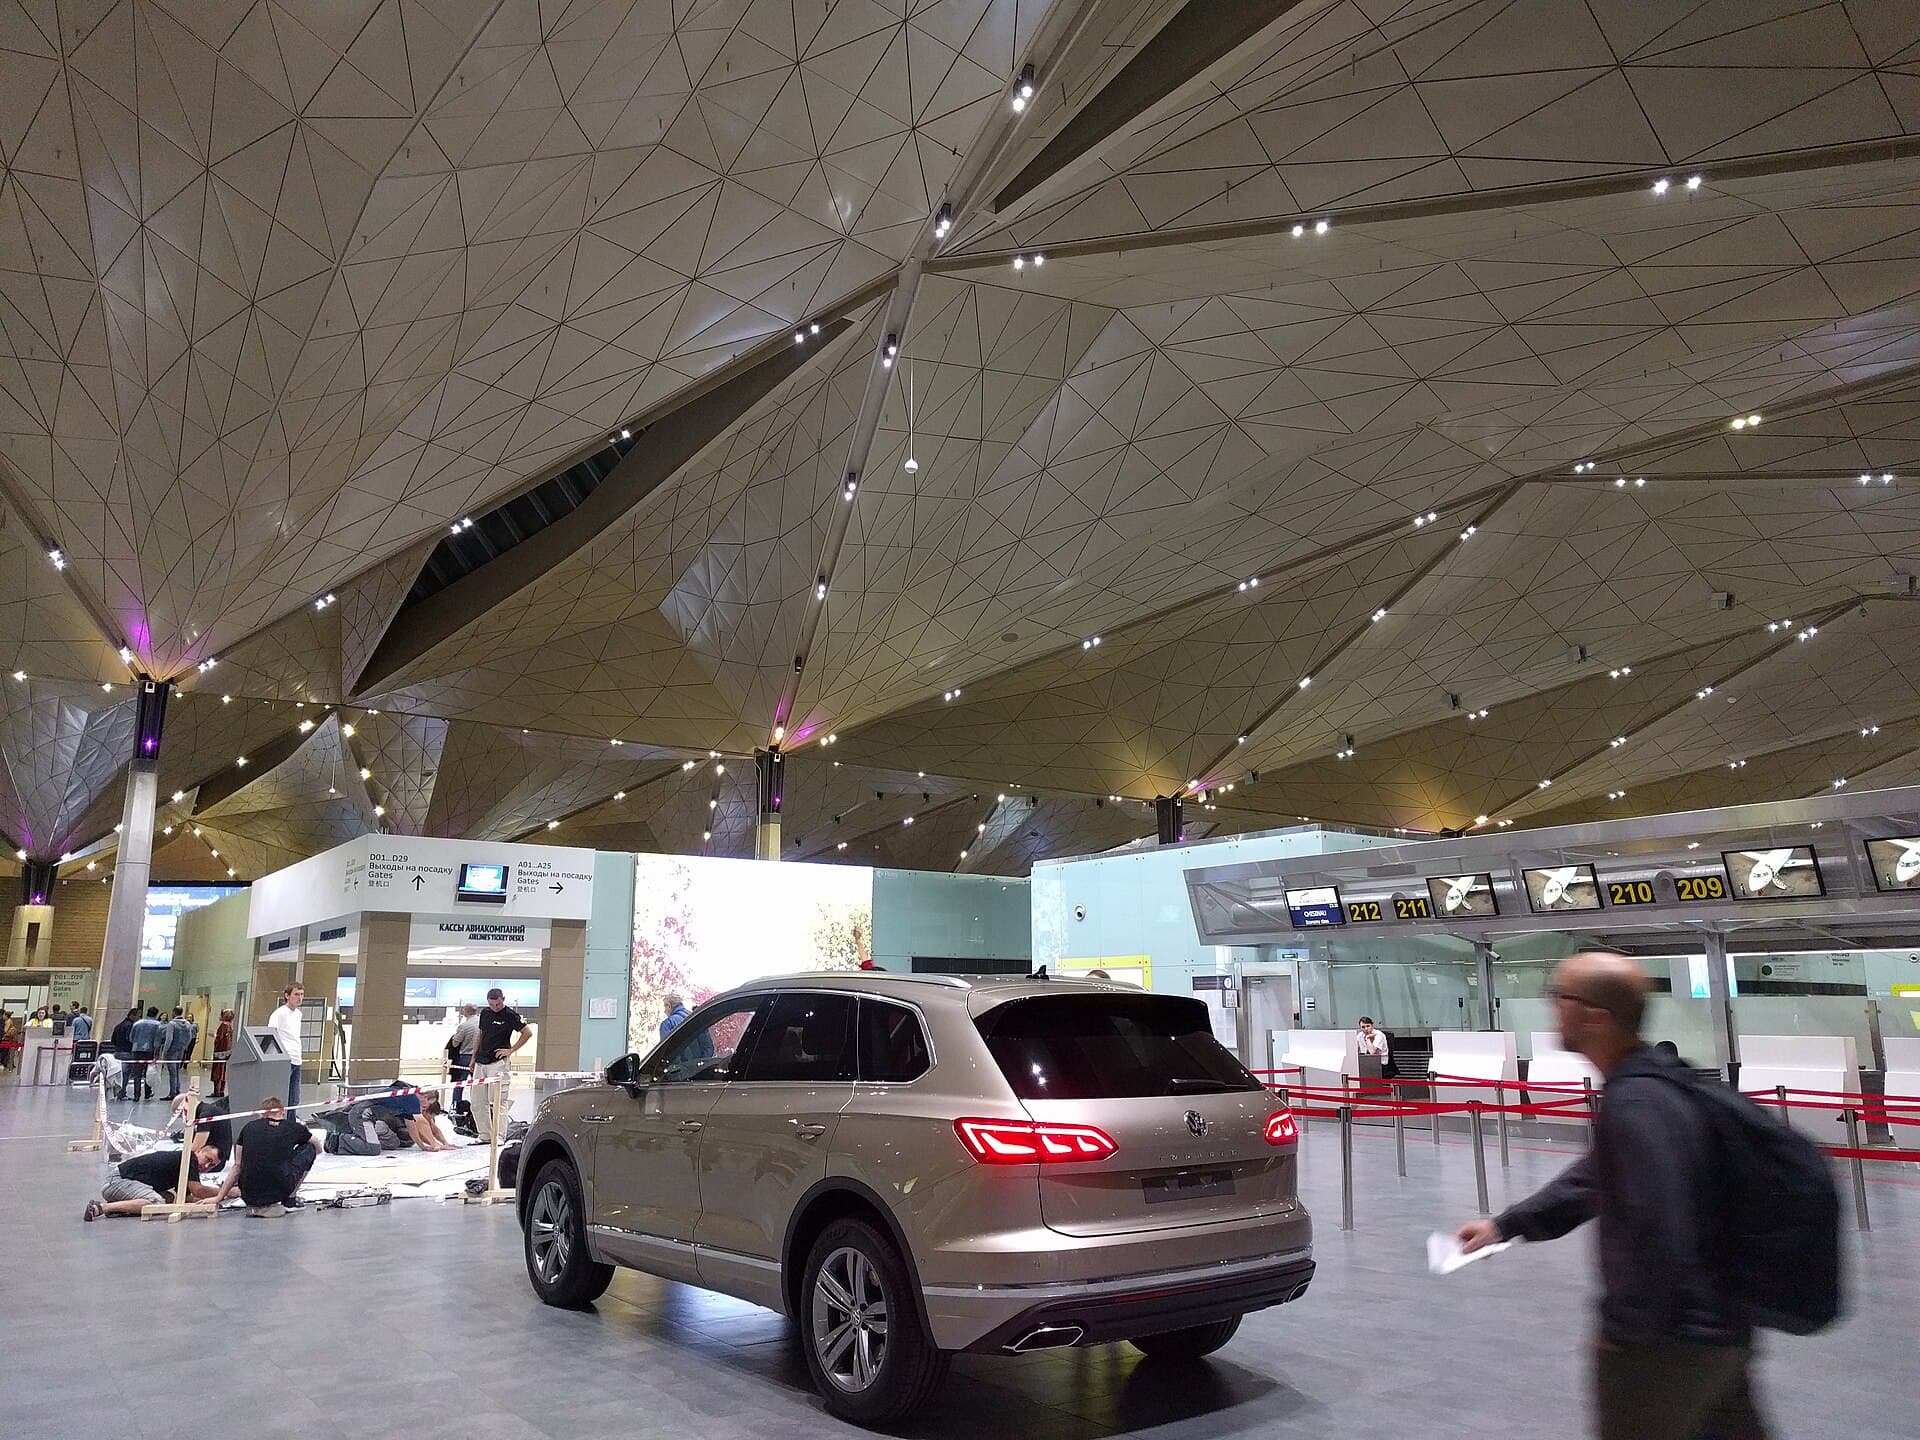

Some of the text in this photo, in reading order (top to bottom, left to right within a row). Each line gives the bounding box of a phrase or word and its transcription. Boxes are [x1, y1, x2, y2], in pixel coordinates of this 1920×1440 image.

[369, 862, 404, 871] Выходы
[418, 866, 453, 874] посадку
[368, 871, 393, 879] Gates
[517, 869, 549, 878] Выходы
[561, 873, 593, 882] посадку
[517, 877, 540, 885] Gates
[1610, 882, 1652, 904] 210
[1677, 877, 1723, 900] 209
[1351, 903, 1380, 920] 212
[1396, 899, 1427, 918] 211
[439, 923, 525, 934] КАССЫ АВИАКОМПАНИЙ
